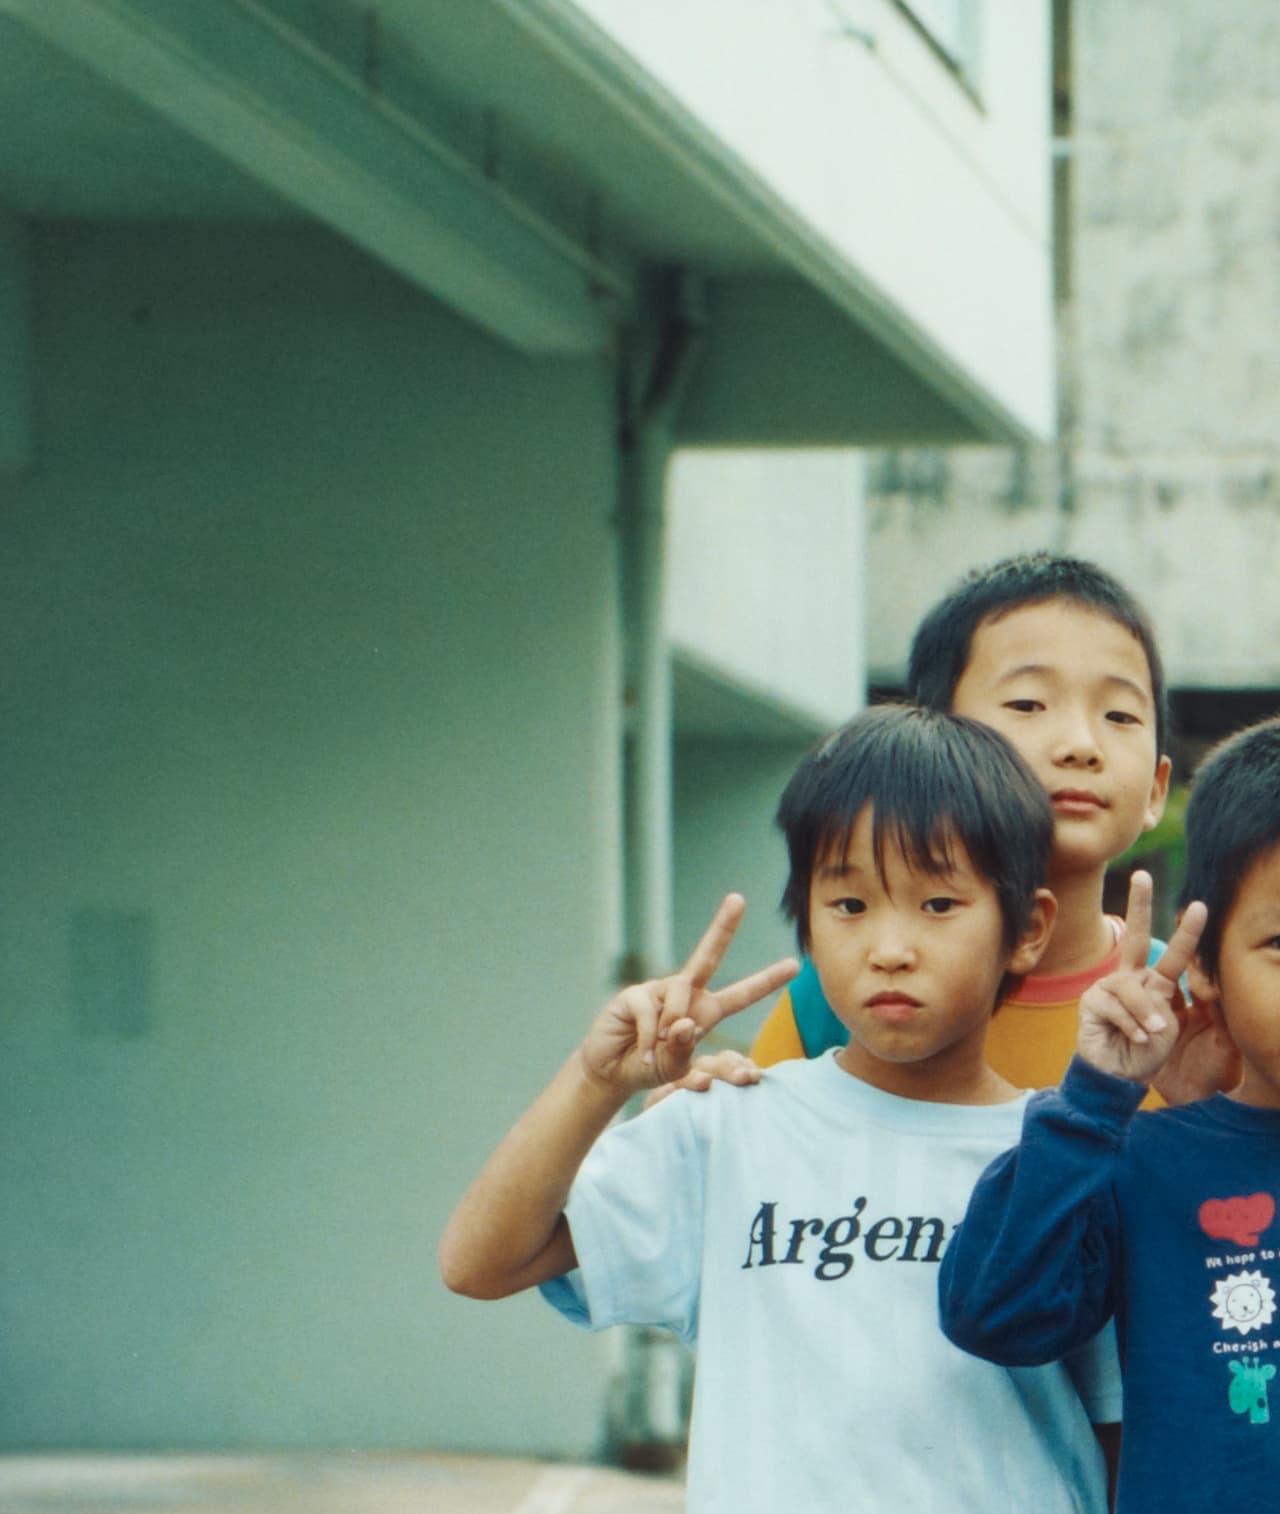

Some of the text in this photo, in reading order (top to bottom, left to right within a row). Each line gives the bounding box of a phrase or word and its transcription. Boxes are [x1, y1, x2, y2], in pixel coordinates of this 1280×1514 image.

[741, 1196, 961, 1281] Argen
[1226, 1252, 1255, 1265] hope
[1261, 1249, 1275, 1260] to
[1213, 1339, 1268, 1354] Cherish
